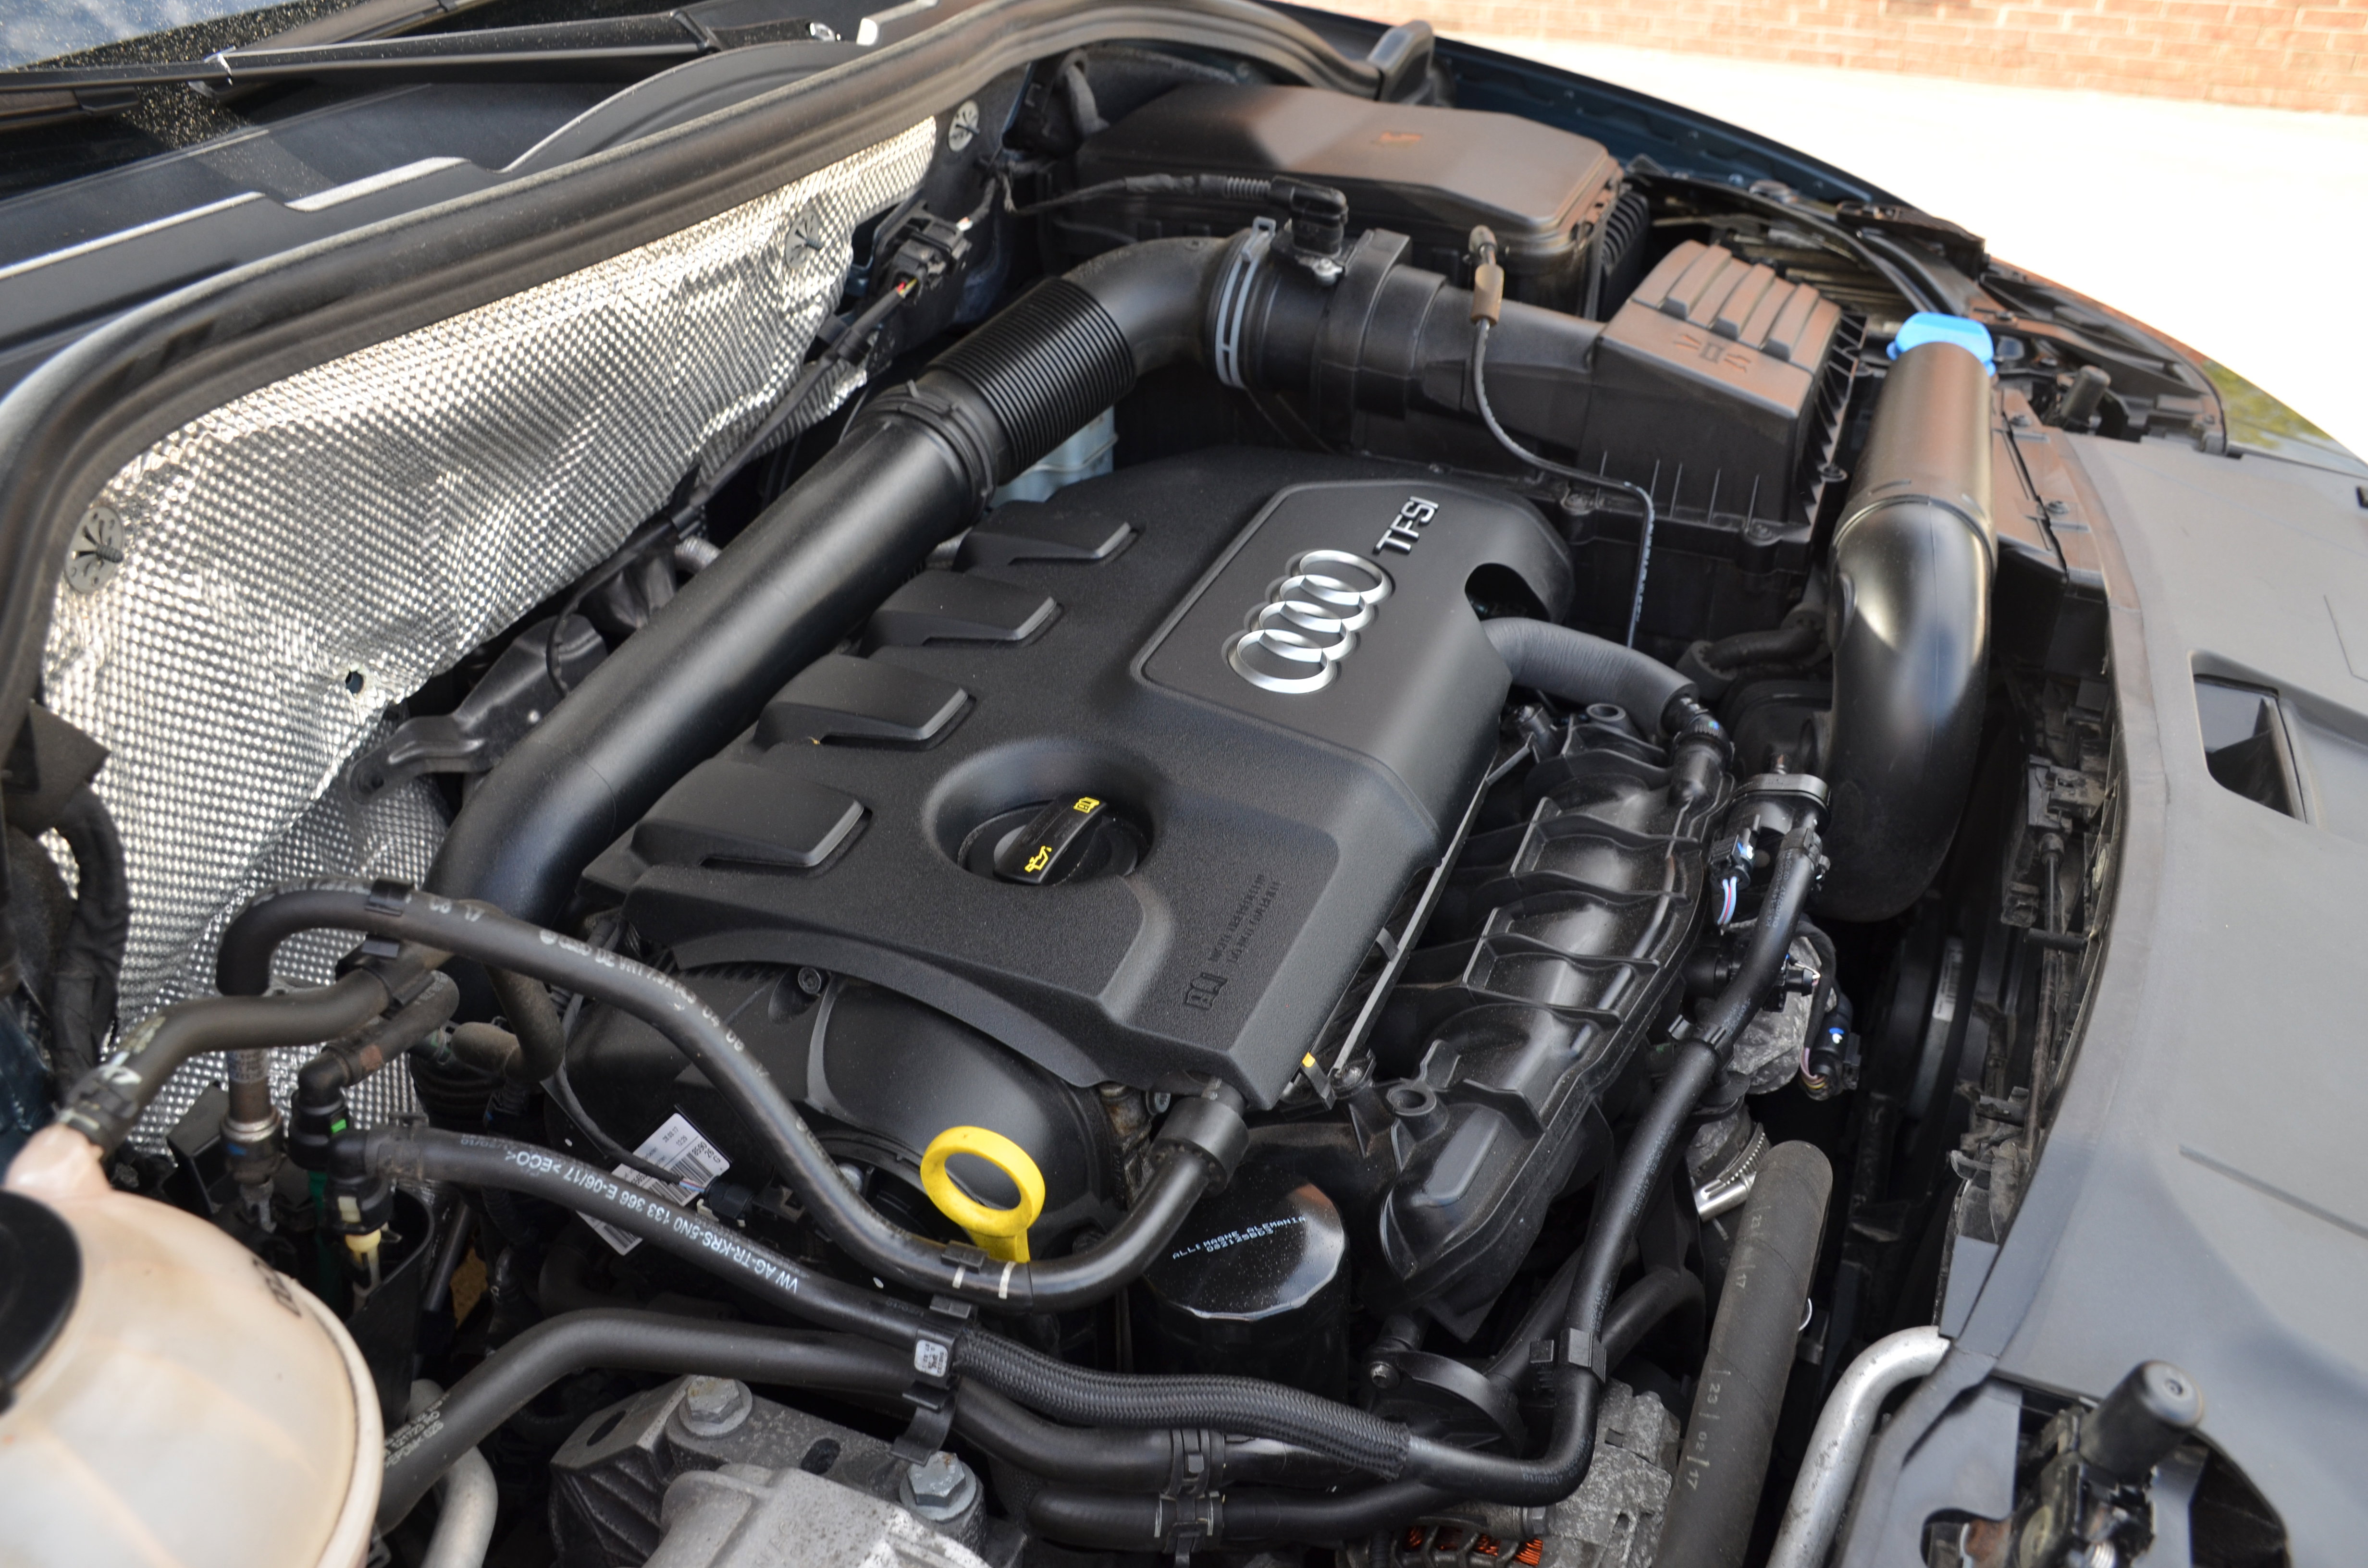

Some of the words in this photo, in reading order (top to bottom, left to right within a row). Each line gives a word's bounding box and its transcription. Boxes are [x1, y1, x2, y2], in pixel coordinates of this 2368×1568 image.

[1374, 496, 1439, 553] TFSI
[563, 1167, 617, 1199] E-06/17
[619, 1191, 646, 1213] 366
[646, 1204, 671, 1225] 133
[673, 1217, 777, 1281] AG-TR-KRS-5N0
[776, 1276, 799, 1294] VW
[1707, 1384, 1722, 1404] 23
[1695, 1433, 1708, 1457] 02
[1685, 1468, 1699, 1491] 17
